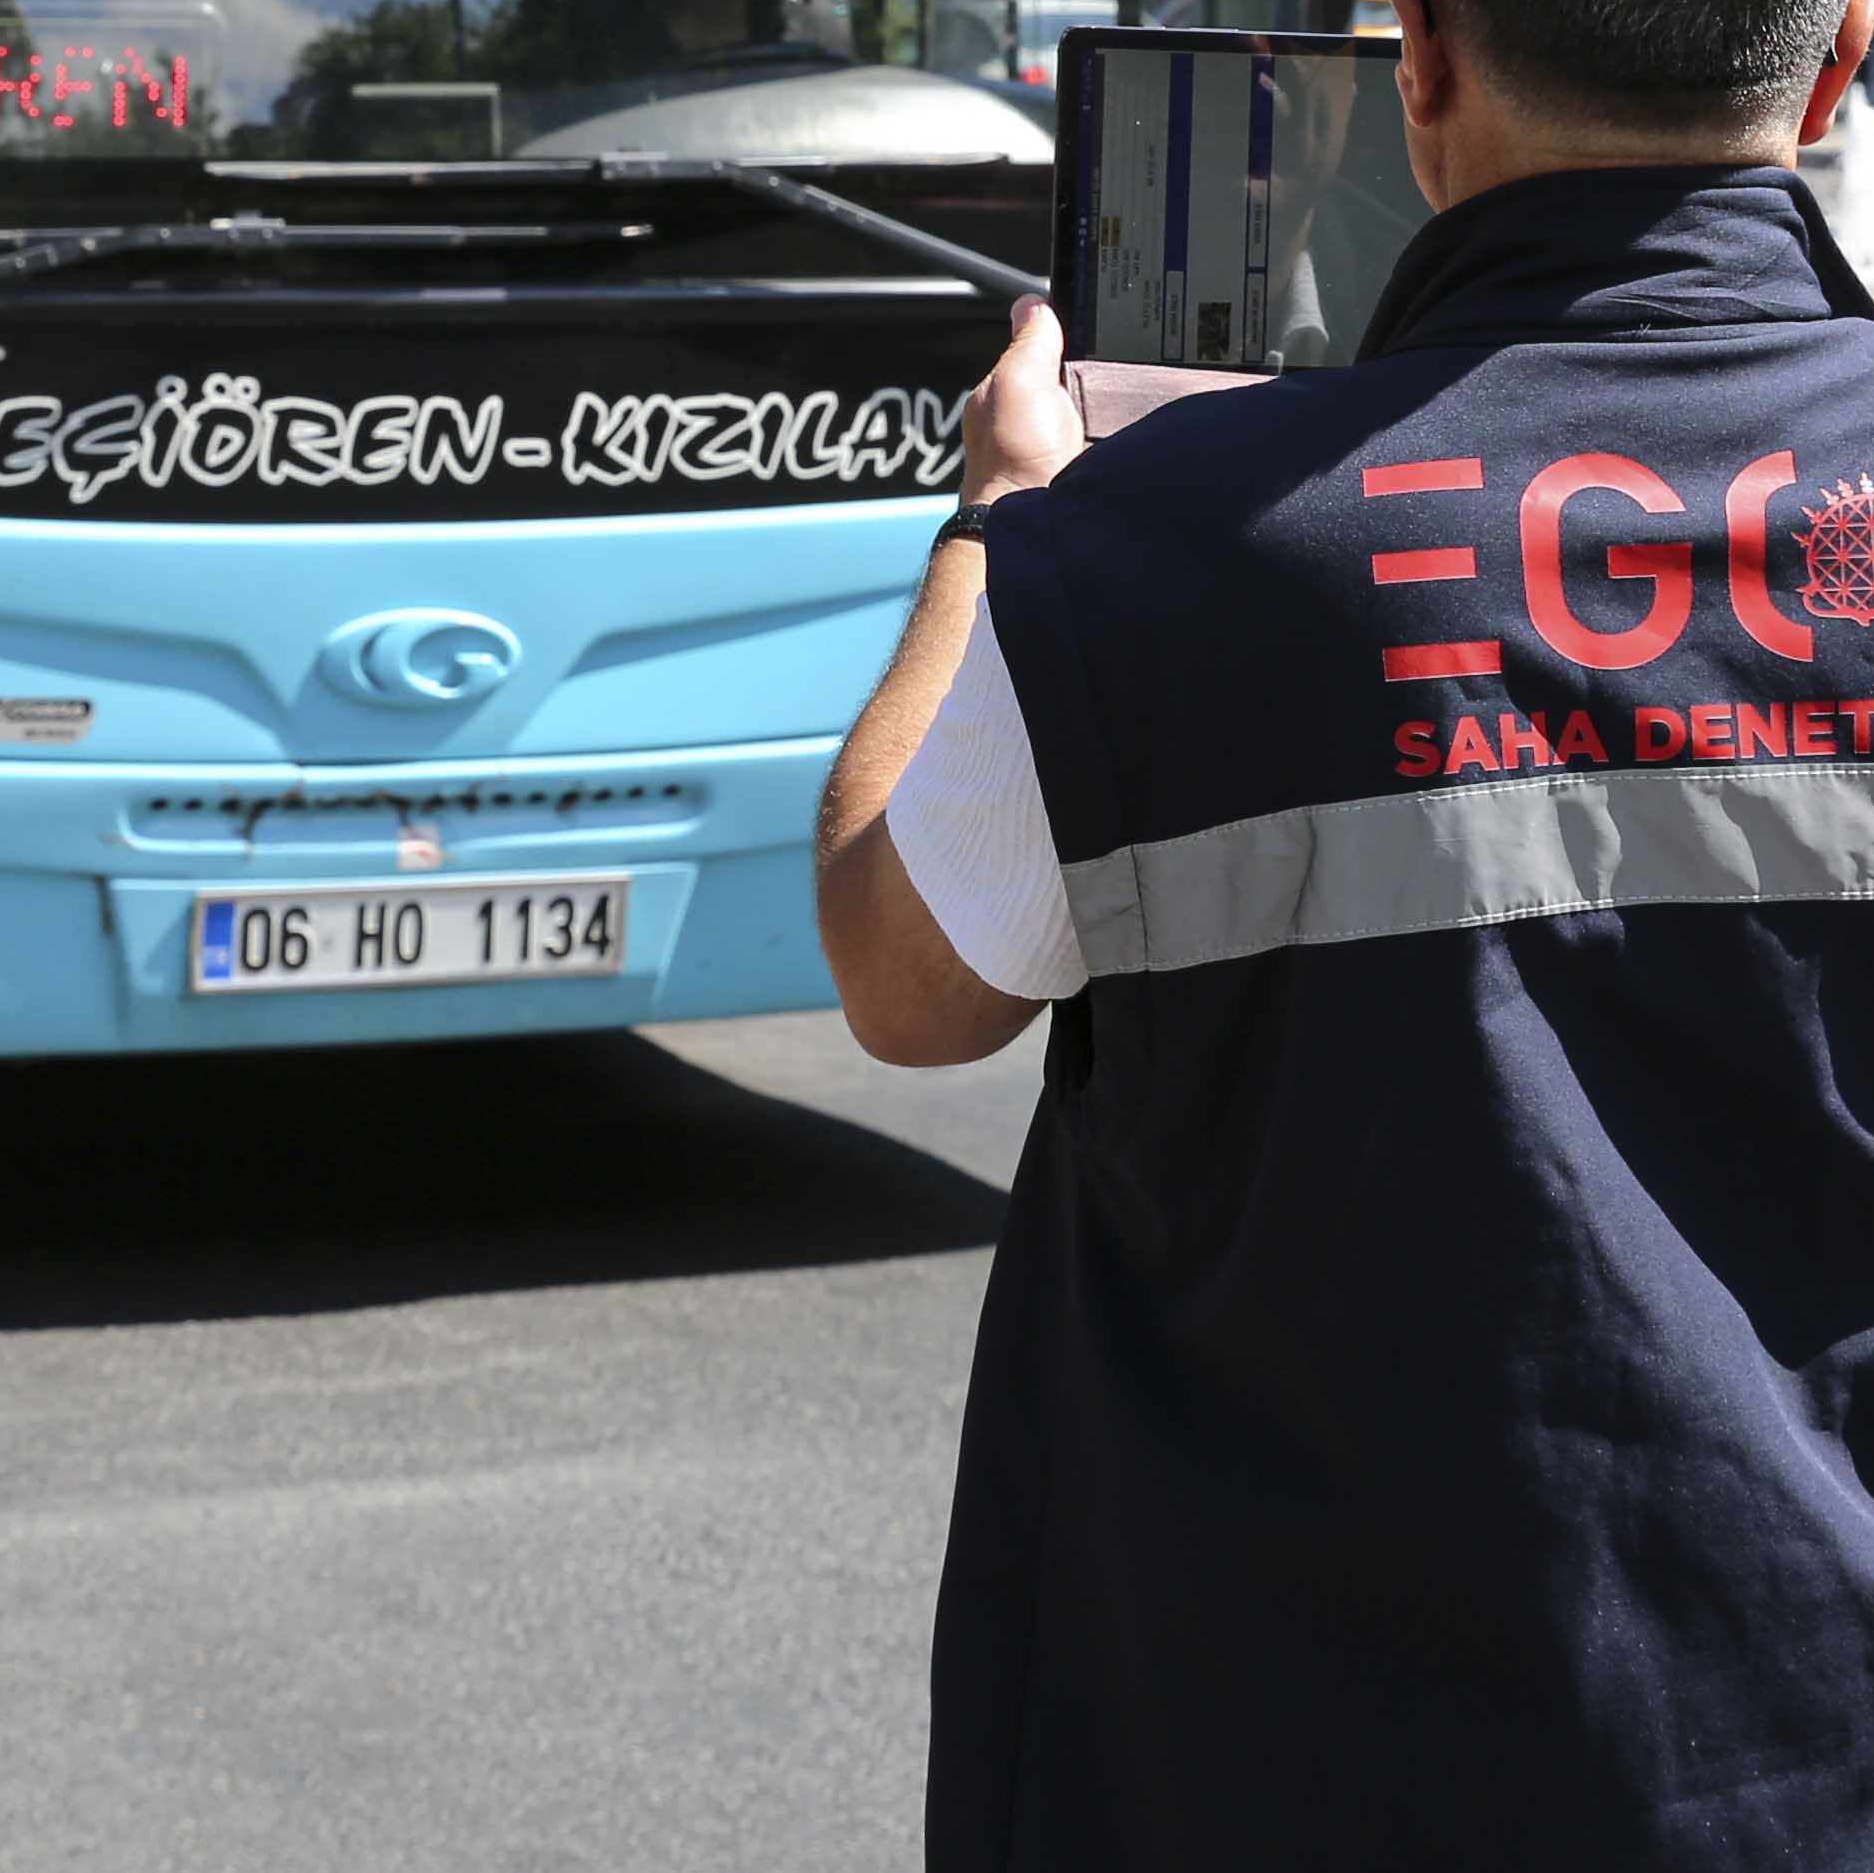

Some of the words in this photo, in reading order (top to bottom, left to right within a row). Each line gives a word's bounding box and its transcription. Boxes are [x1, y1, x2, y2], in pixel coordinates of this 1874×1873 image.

[1394, 710, 1609, 777] SAHA
[241, 908, 309, 973] 06
[354, 902, 424, 968] HO
[478, 894, 613, 963] 1134
